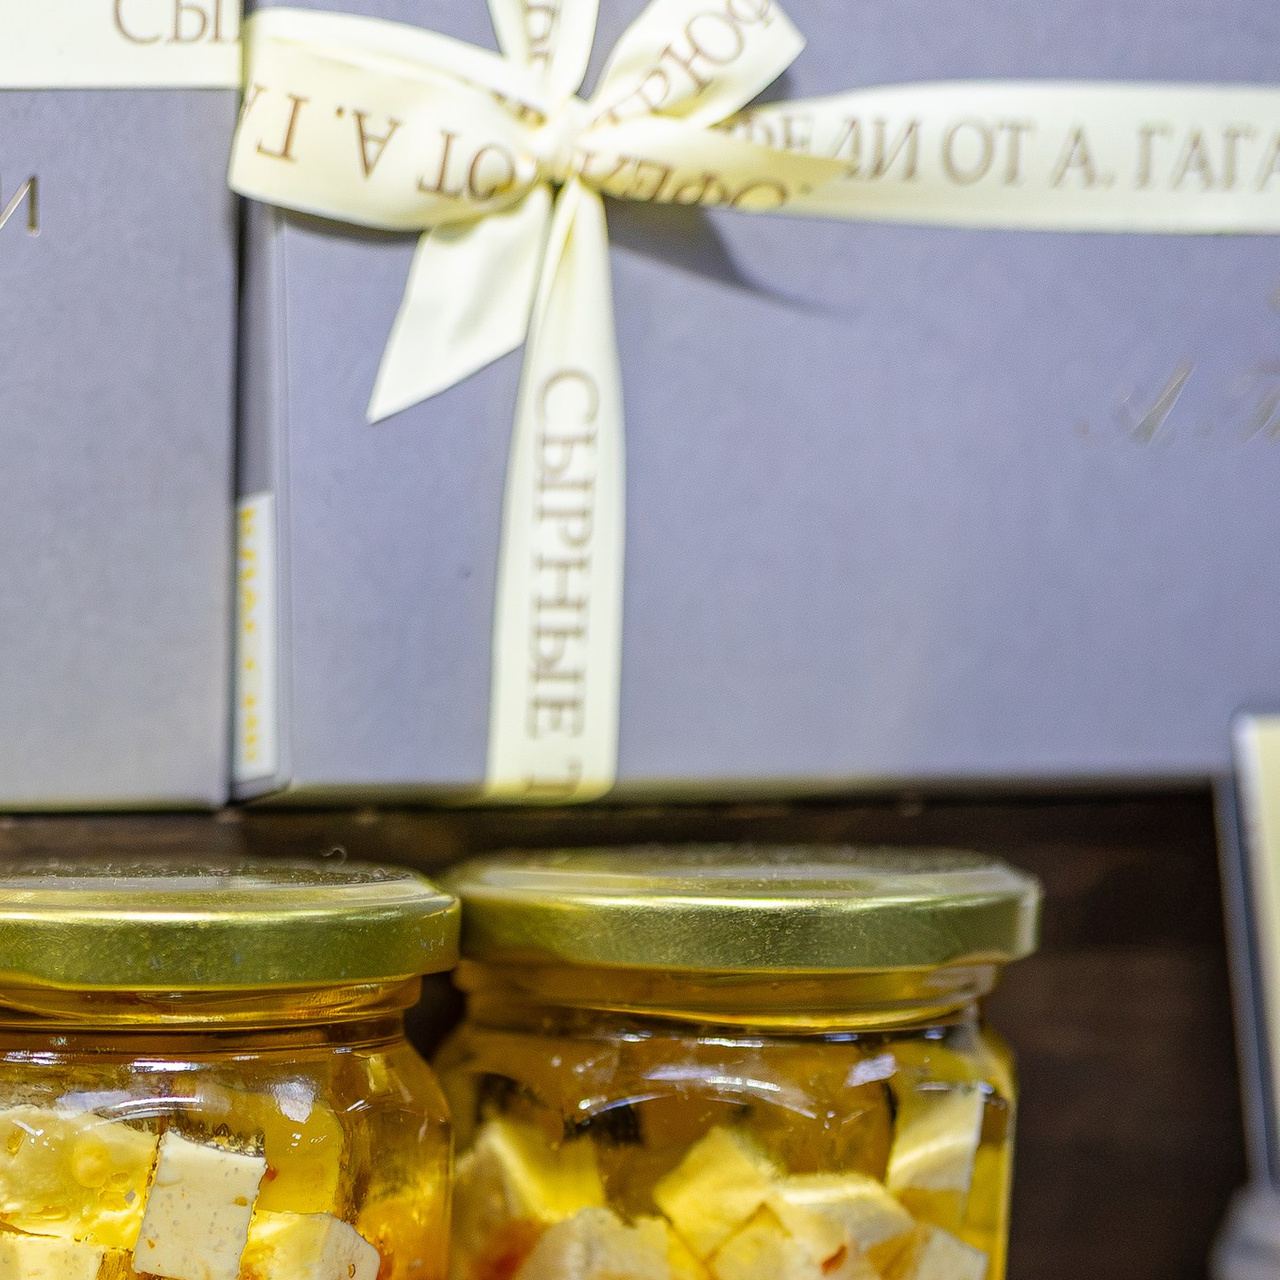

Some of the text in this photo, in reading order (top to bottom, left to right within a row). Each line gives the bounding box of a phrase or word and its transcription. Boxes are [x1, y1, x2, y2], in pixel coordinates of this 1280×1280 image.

[111, 0, 240, 44] СЫ
[939, 118, 1036, 186] ОТ
[527, 368, 601, 739] СЫРНЫЕ
